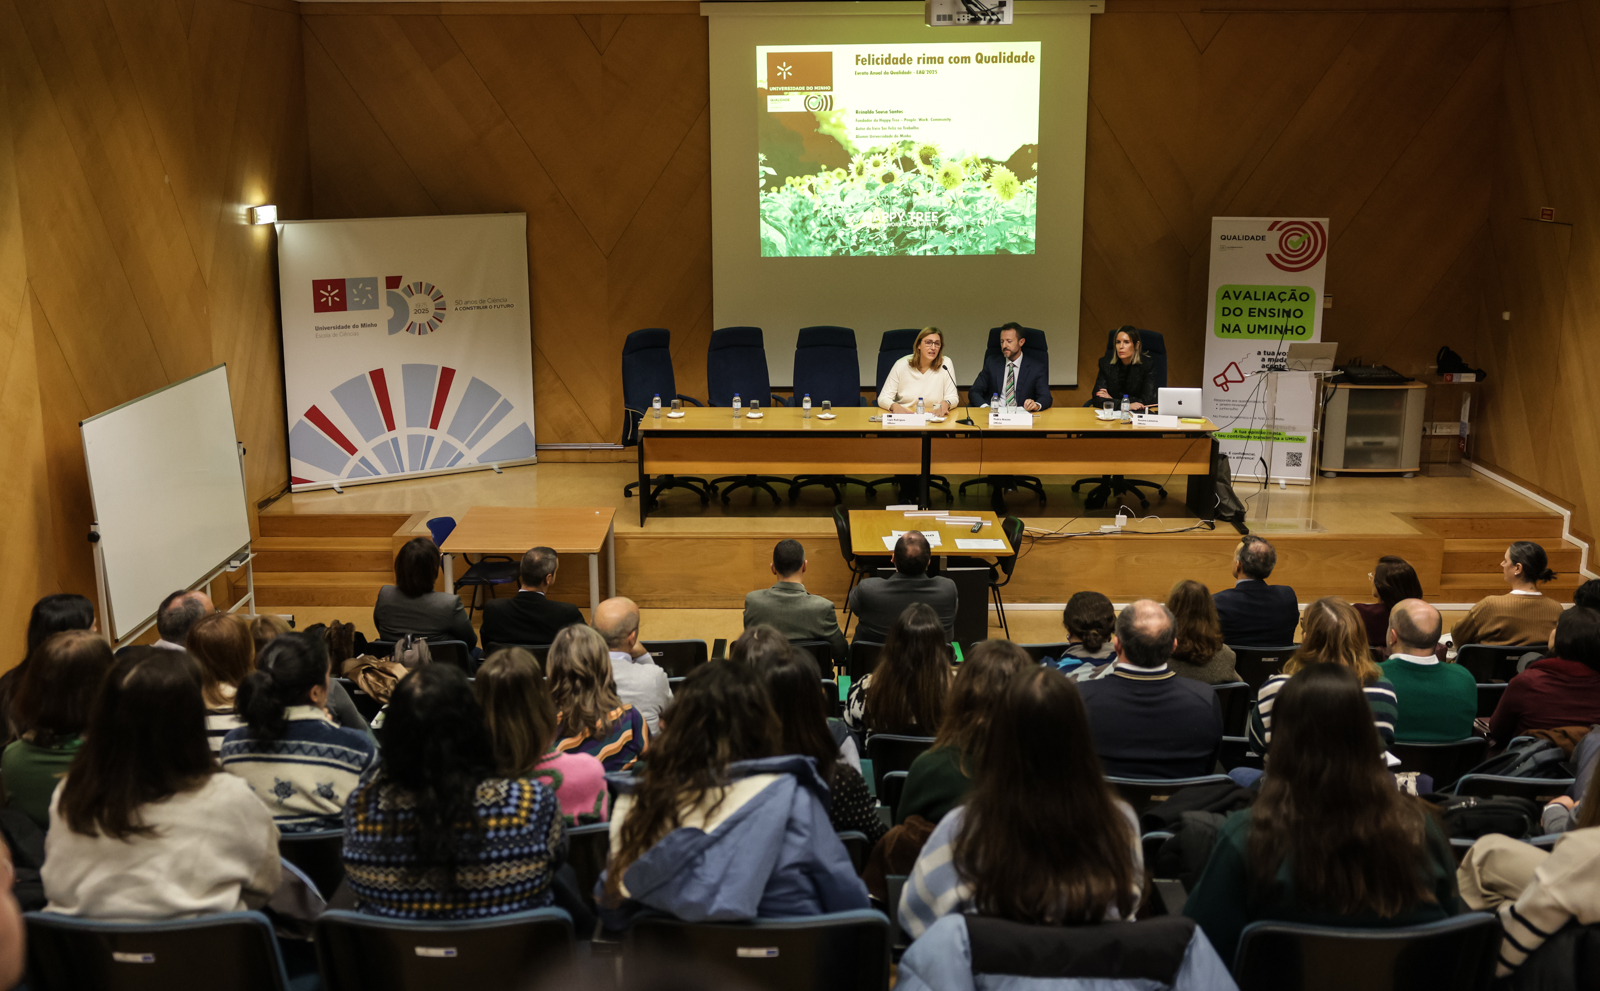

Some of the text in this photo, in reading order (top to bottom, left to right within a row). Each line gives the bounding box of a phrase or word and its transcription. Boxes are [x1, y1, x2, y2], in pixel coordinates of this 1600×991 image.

[855, 51, 1036, 65] Felicidade rima com Qualidade
[864, 211, 939, 222] HAPPY TREE
[1221, 288, 1310, 304] AVALIAÇÃO
[1221, 306, 1304, 319] DO ENSINO
[1221, 323, 1306, 336] NA UMINHO
